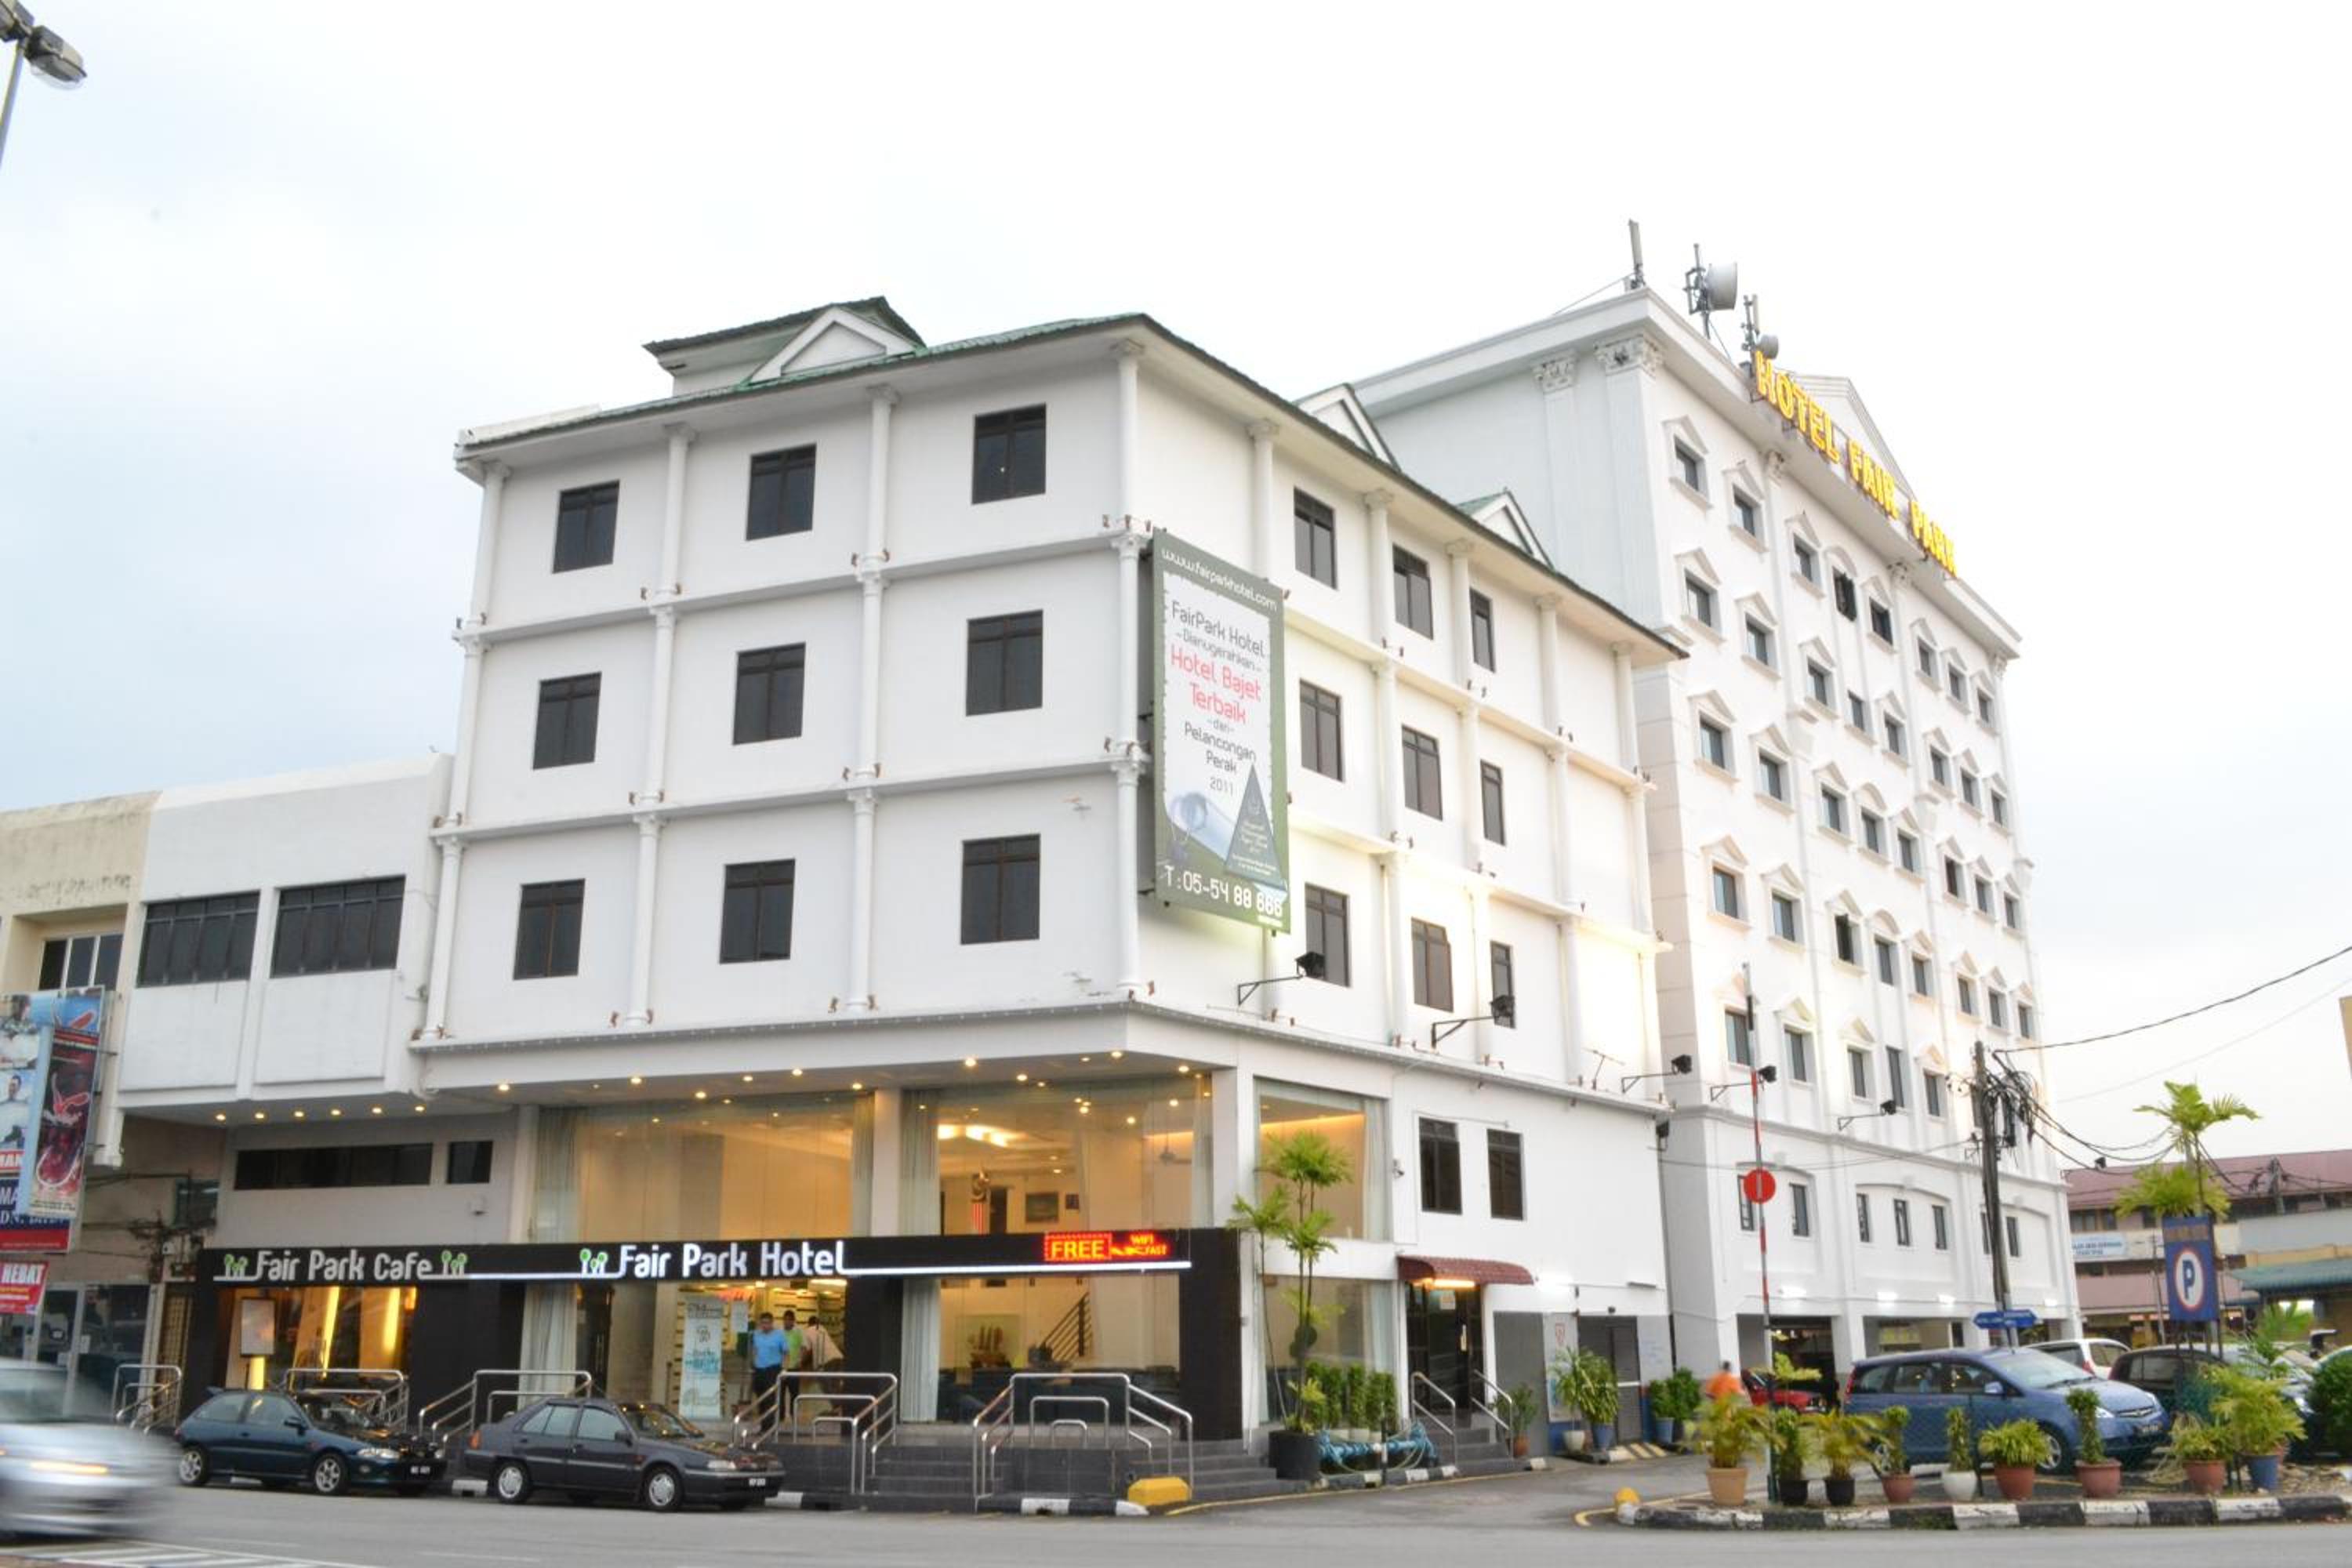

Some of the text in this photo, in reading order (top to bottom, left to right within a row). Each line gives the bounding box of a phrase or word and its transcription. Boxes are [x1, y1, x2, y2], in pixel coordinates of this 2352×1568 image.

[1756, 350, 1957, 578] HOTEL FAIR PARK
[1161, 549, 1278, 612] www.fairparkhotel.com
[1171, 600, 1265, 658] FairPark Hotel
[1171, 643, 1261, 702] Hotel Bajet
[1189, 681, 1247, 724] Terbaik
[1185, 720, 1257, 763] Pelancongan
[1205, 750, 1237, 775] Perak
[1210, 777, 1234, 796] 2011
[1233, 885, 1252, 908] 88
[618, 1240, 845, 1278] Fair Park Hotel
[1051, 1240, 1105, 1258] FREE
[1130, 1234, 1155, 1245] WIFI
[254, 1249, 433, 1281] Fair Park Cafe
[2182, 1259, 2195, 1301] P
